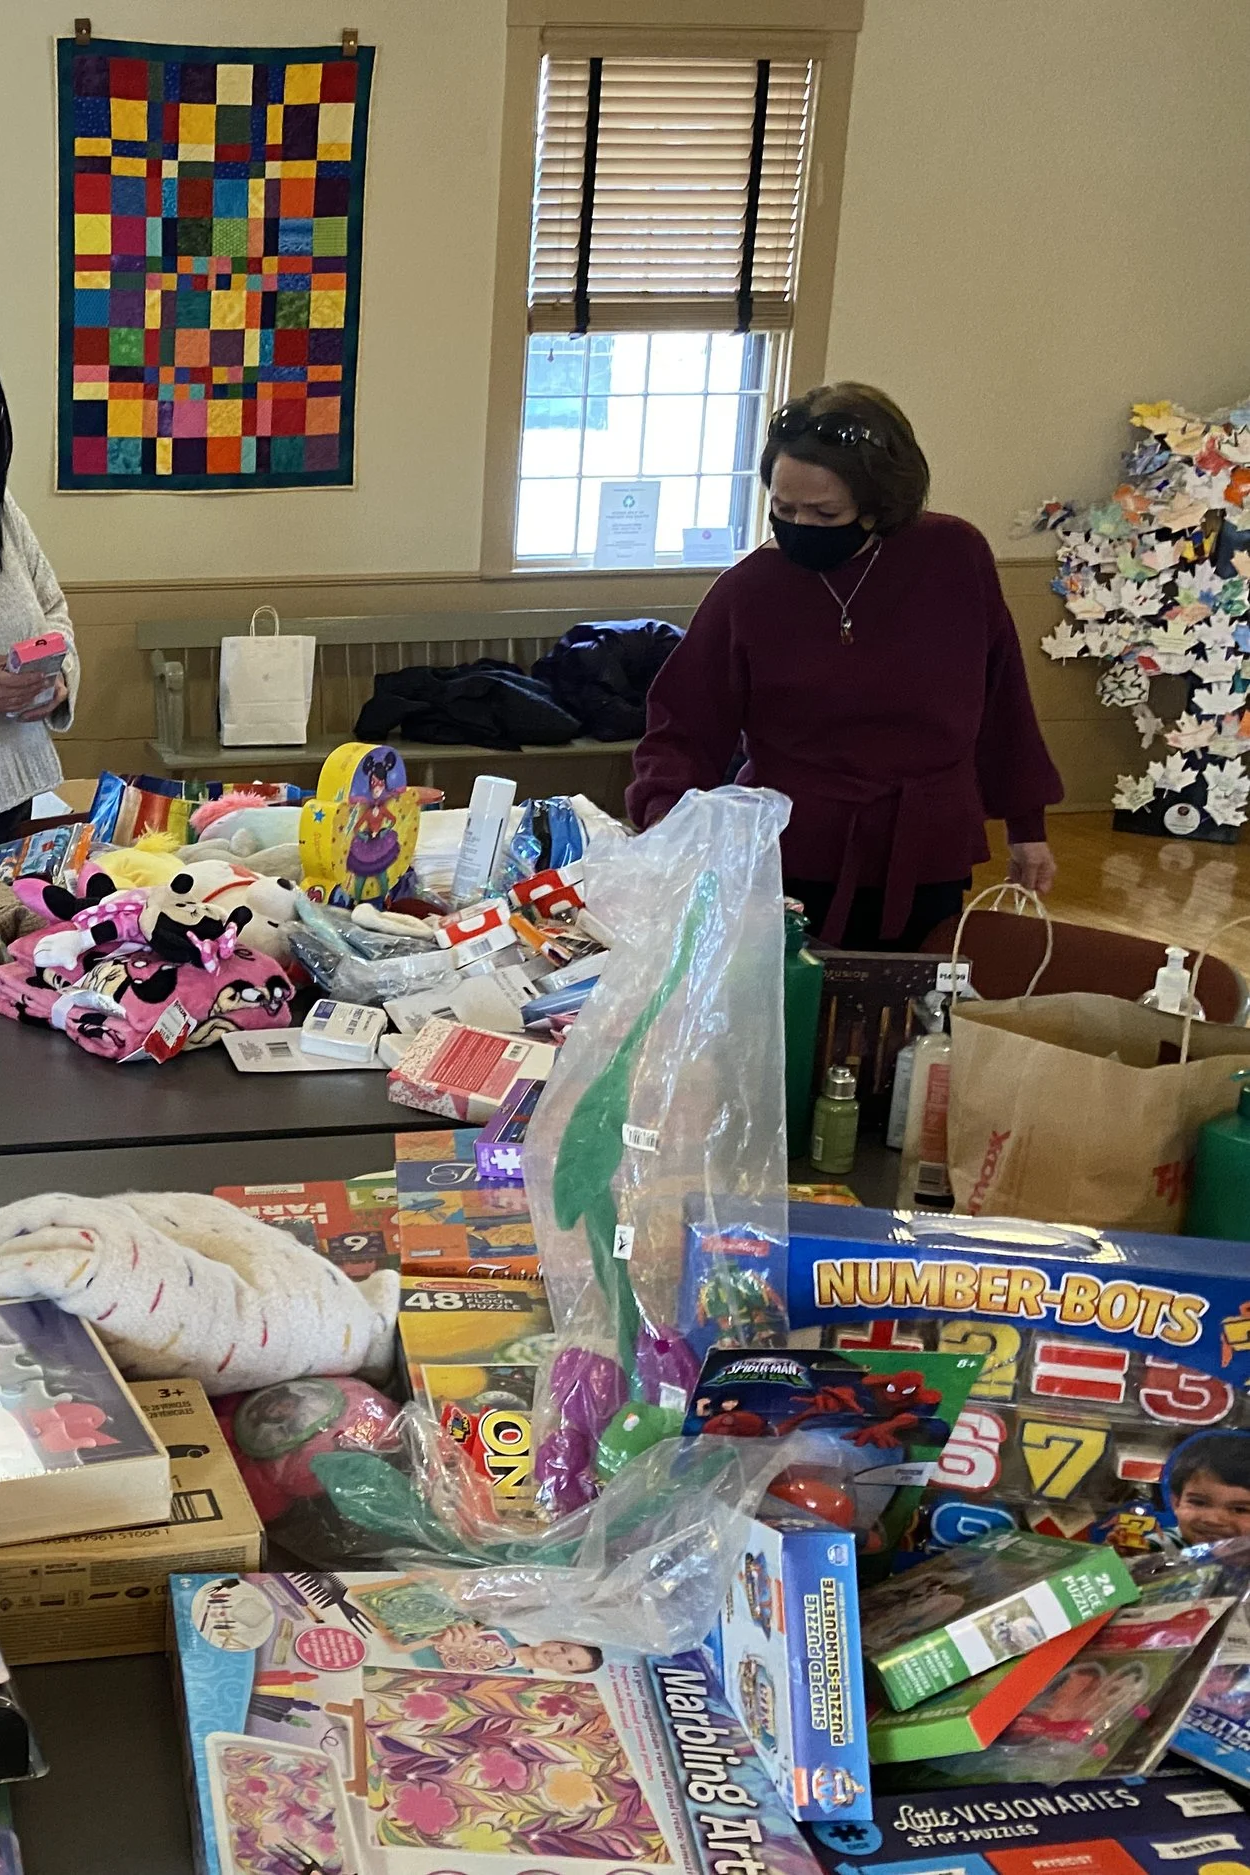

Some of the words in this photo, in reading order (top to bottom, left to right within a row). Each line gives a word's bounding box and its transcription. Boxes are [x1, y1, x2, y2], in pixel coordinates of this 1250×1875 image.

[404, 1291, 463, 1310] 48
[814, 1260, 1209, 1344] NUMBER-BOTS
[157, 1388, 185, 1399] 3+
[1019, 1419, 1111, 1501] 7
[1061, 1575, 1094, 1620] PUZZLE
[804, 1595, 824, 1659] PUZZLE
[808, 1660, 828, 1731] SHAPED
[657, 1667, 758, 1807] Marbling
[659, 1771, 675, 1791] wild
[666, 1792, 679, 1810] and
[894, 1806, 958, 1833] Little
[953, 1788, 1141, 1823] VISIONARIES
[907, 1833, 937, 1848] SET
[938, 1831, 960, 1845] OF
[970, 1823, 1039, 1841] PUZZLES
